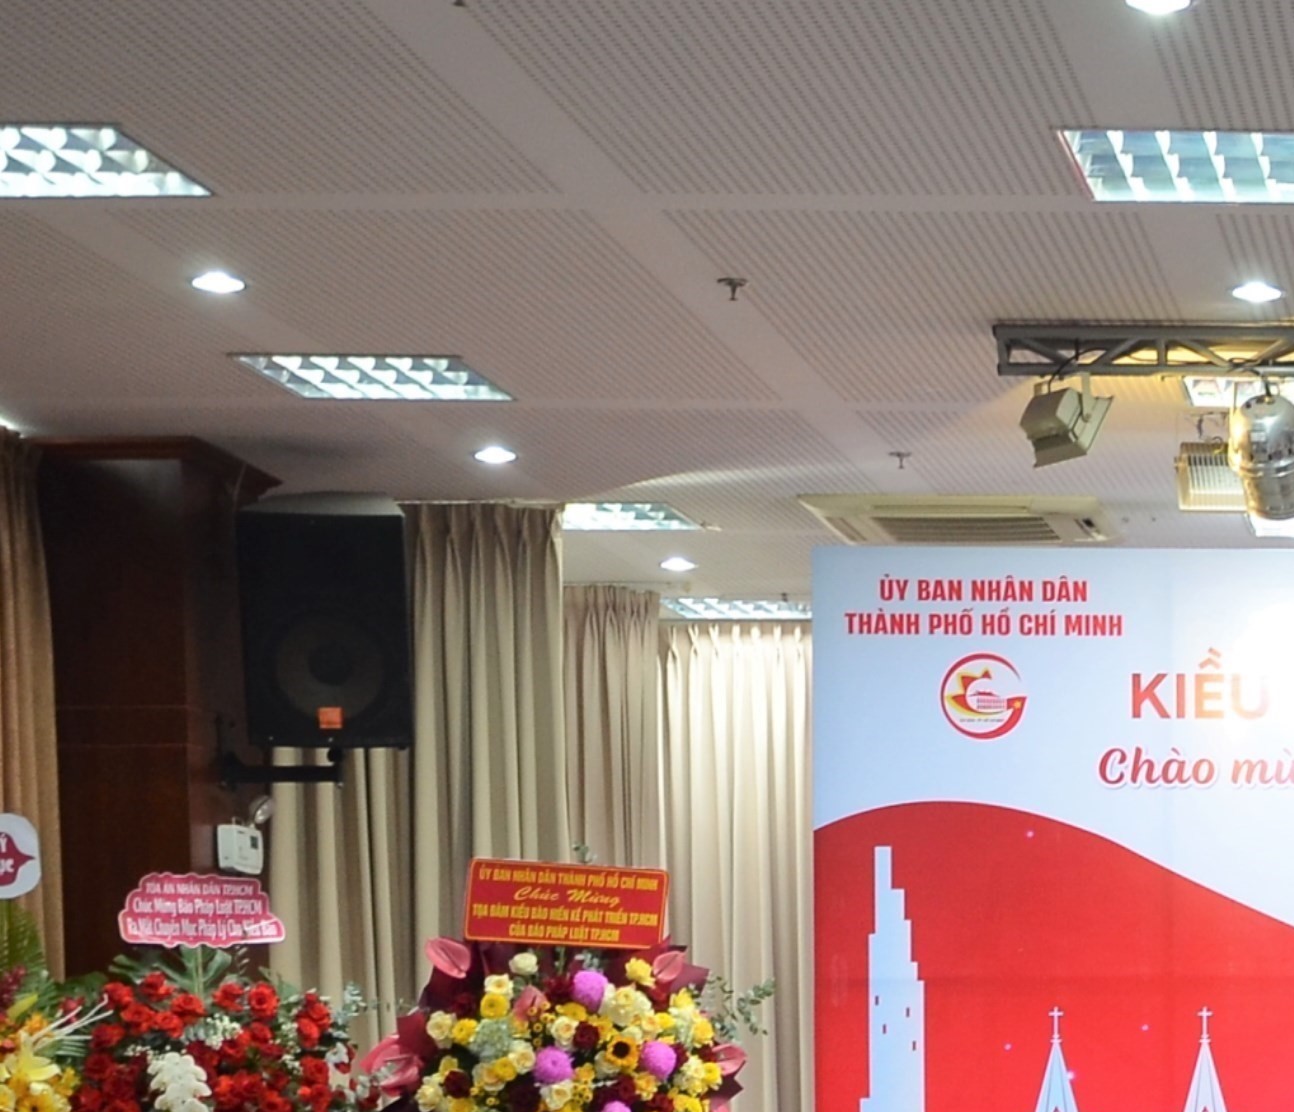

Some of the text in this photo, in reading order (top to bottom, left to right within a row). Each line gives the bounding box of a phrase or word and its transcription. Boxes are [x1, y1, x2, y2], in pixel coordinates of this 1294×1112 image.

[880, 574, 1088, 602] ỦY BAN NHÂN DÂN
[844, 607, 1122, 637] THÀNH PHỐ HỒ CHÍ MINH
[1130, 648, 1270, 720] KIỀU
[1100, 746, 1215, 786] Chào
[133, 898, 153, 912] Chúc
[514, 886, 620, 906] Chúc Mừng
